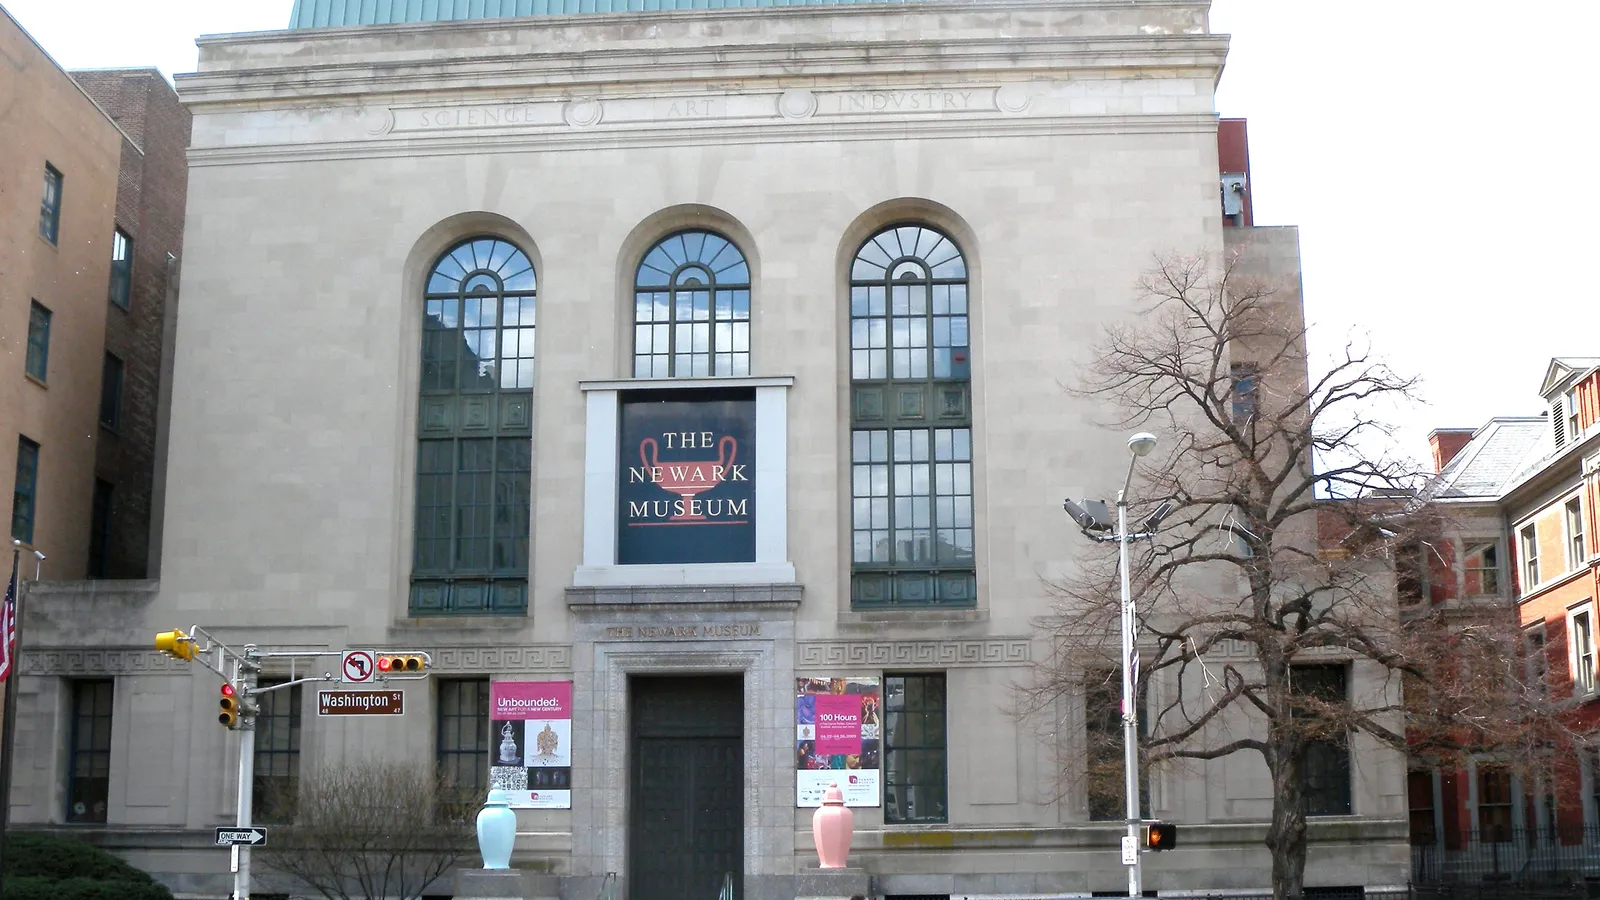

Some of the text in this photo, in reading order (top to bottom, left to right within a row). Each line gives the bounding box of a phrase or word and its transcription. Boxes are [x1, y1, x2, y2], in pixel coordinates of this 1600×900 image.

[667, 99, 715, 117] ART
[838, 92, 972, 112] INDVSTRY
[420, 107, 535, 127] SCIENCE
[663, 431, 715, 449] THE
[629, 464, 749, 483] NEWARK
[629, 498, 748, 517] MUSEUM
[606, 624, 761, 638] THE NEWARK MUSEUM
[321, 693, 389, 711] Washington
[498, 698, 559, 707] Unbounded:
[820, 713, 857, 721] 100 Hours
[220, 832, 235, 840] ONE
